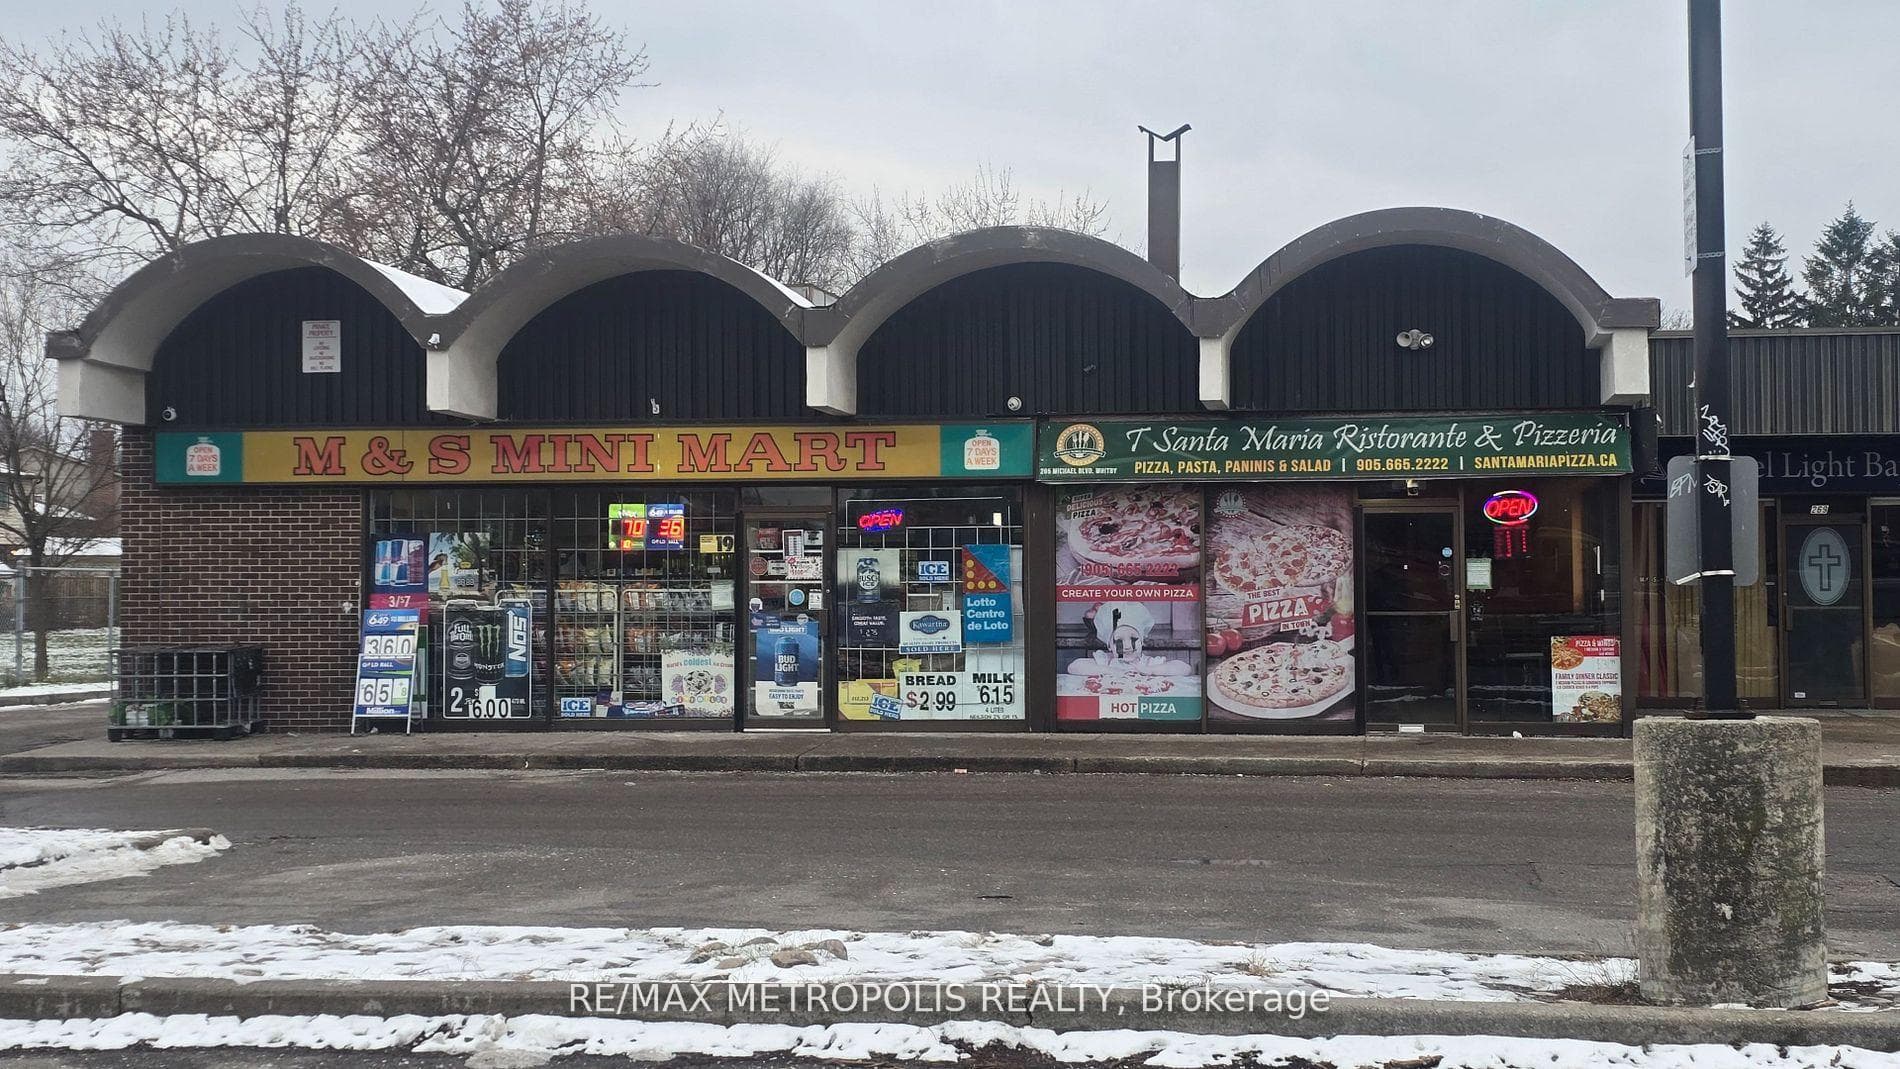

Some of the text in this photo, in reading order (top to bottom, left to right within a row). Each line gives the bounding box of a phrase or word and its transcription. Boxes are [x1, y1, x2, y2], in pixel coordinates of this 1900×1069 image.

[1126, 420, 1618, 453] T Santa Maria Ristorante & Pizzeria
[293, 430, 896, 475] M & S MINI MART
[967, 448, 997, 456] 7 DAYS
[189, 454, 217, 462] 7 DAYS
[966, 457, 997, 465] A WEEK
[1474, 453, 1618, 469] SANTAMARIAPIZZA.CA
[1134, 458, 1332, 475] PIZZA, PASTA, PANINIS & SALAD
[1356, 457, 1449, 471] 905.665.2222
[1781, 450, 1856, 487] Light
[1863, 451, 1900, 478] Ba
[1066, 498, 1104, 511] DELICIOUS
[1485, 498, 1534, 517] OPEN
[1073, 509, 1096, 519] PIZZA
[859, 513, 903, 528] OPEN
[624, 519, 643, 537] 70
[659, 519, 681, 536] 36
[716, 536, 733, 551] 19
[920, 563, 947, 575] ICE
[1061, 588, 1194, 598] CREATE YOUR OWN PIZZA
[1247, 588, 1281, 599] THE BEST
[967, 597, 997, 607] Lotto
[967, 609, 1005, 619] Centre
[1248, 598, 1309, 624] PIZZA
[967, 621, 1009, 631] de Loto
[1292, 621, 1311, 629] TOWN
[1575, 639, 1591, 647] PIZZA
[683, 658, 712, 666] coldest
[778, 655, 796, 664] BUD
[474, 662, 504, 671] MONSTER
[775, 663, 800, 672] LIGHT
[905, 675, 957, 686] BREAD
[972, 673, 1014, 684] MILK
[1596, 672, 1619, 680] CLASSIC
[450, 687, 463, 713] 2
[472, 699, 509, 718] 6.00
[562, 700, 589, 711] ICE
[872, 697, 899, 711] ICE
[906, 690, 956, 711] $2.99
[1111, 702, 1177, 714] HOT PIZZA
